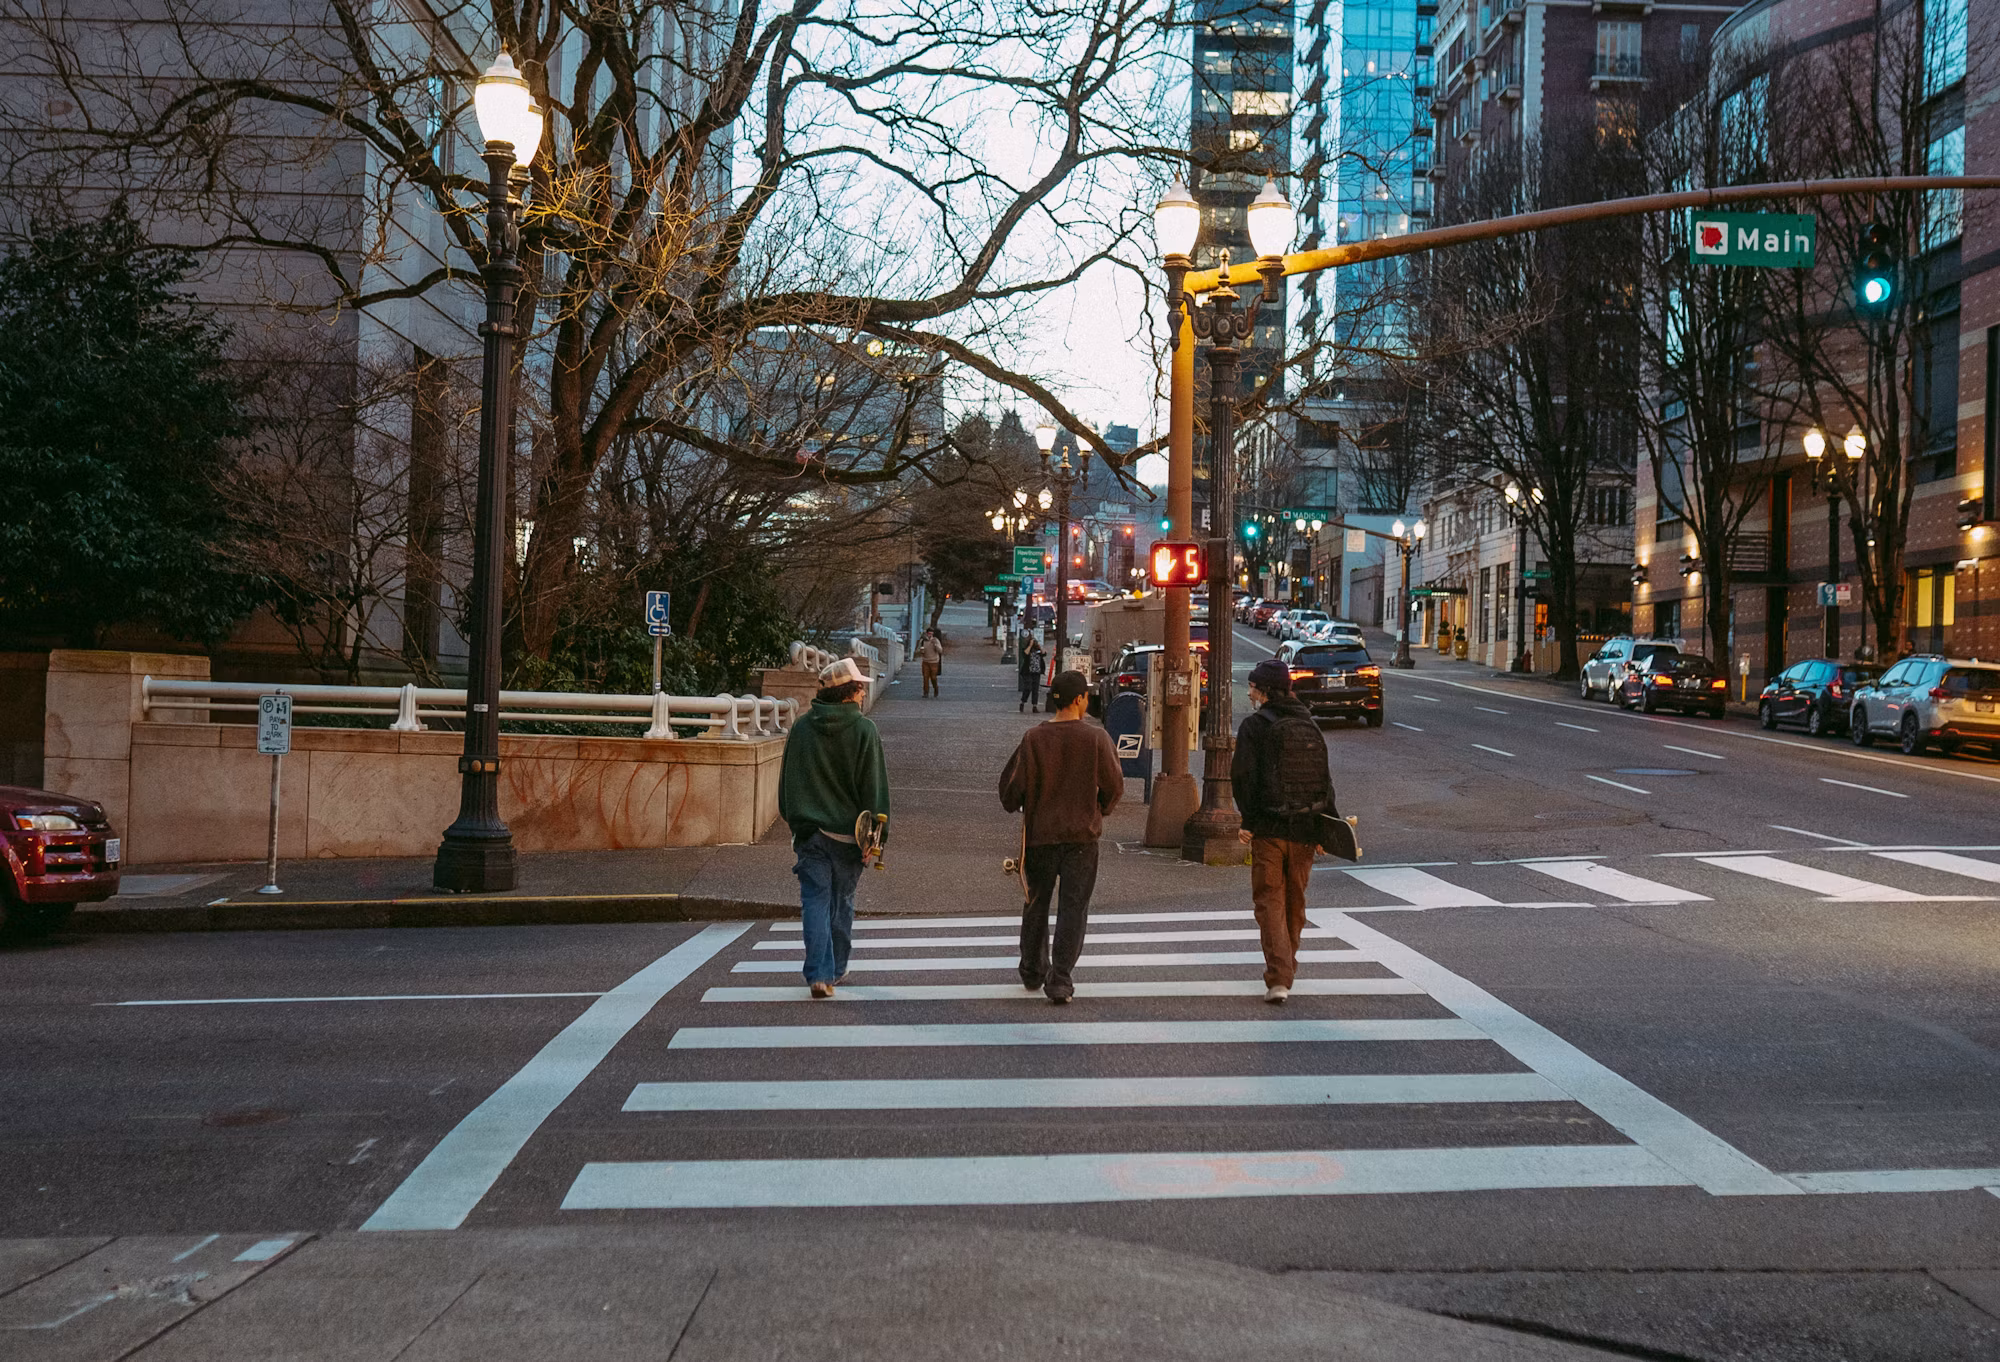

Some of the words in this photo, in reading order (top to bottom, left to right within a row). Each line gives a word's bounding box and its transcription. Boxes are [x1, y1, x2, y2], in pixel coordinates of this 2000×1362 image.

[1737, 227, 1810, 253] Main
[1292, 511, 1326, 520] MADISON
[1022, 557, 1038, 565] Bridge
[1185, 549, 1198, 579] 5
[269, 716, 281, 724] PAY
[270, 723, 279, 731] TO
